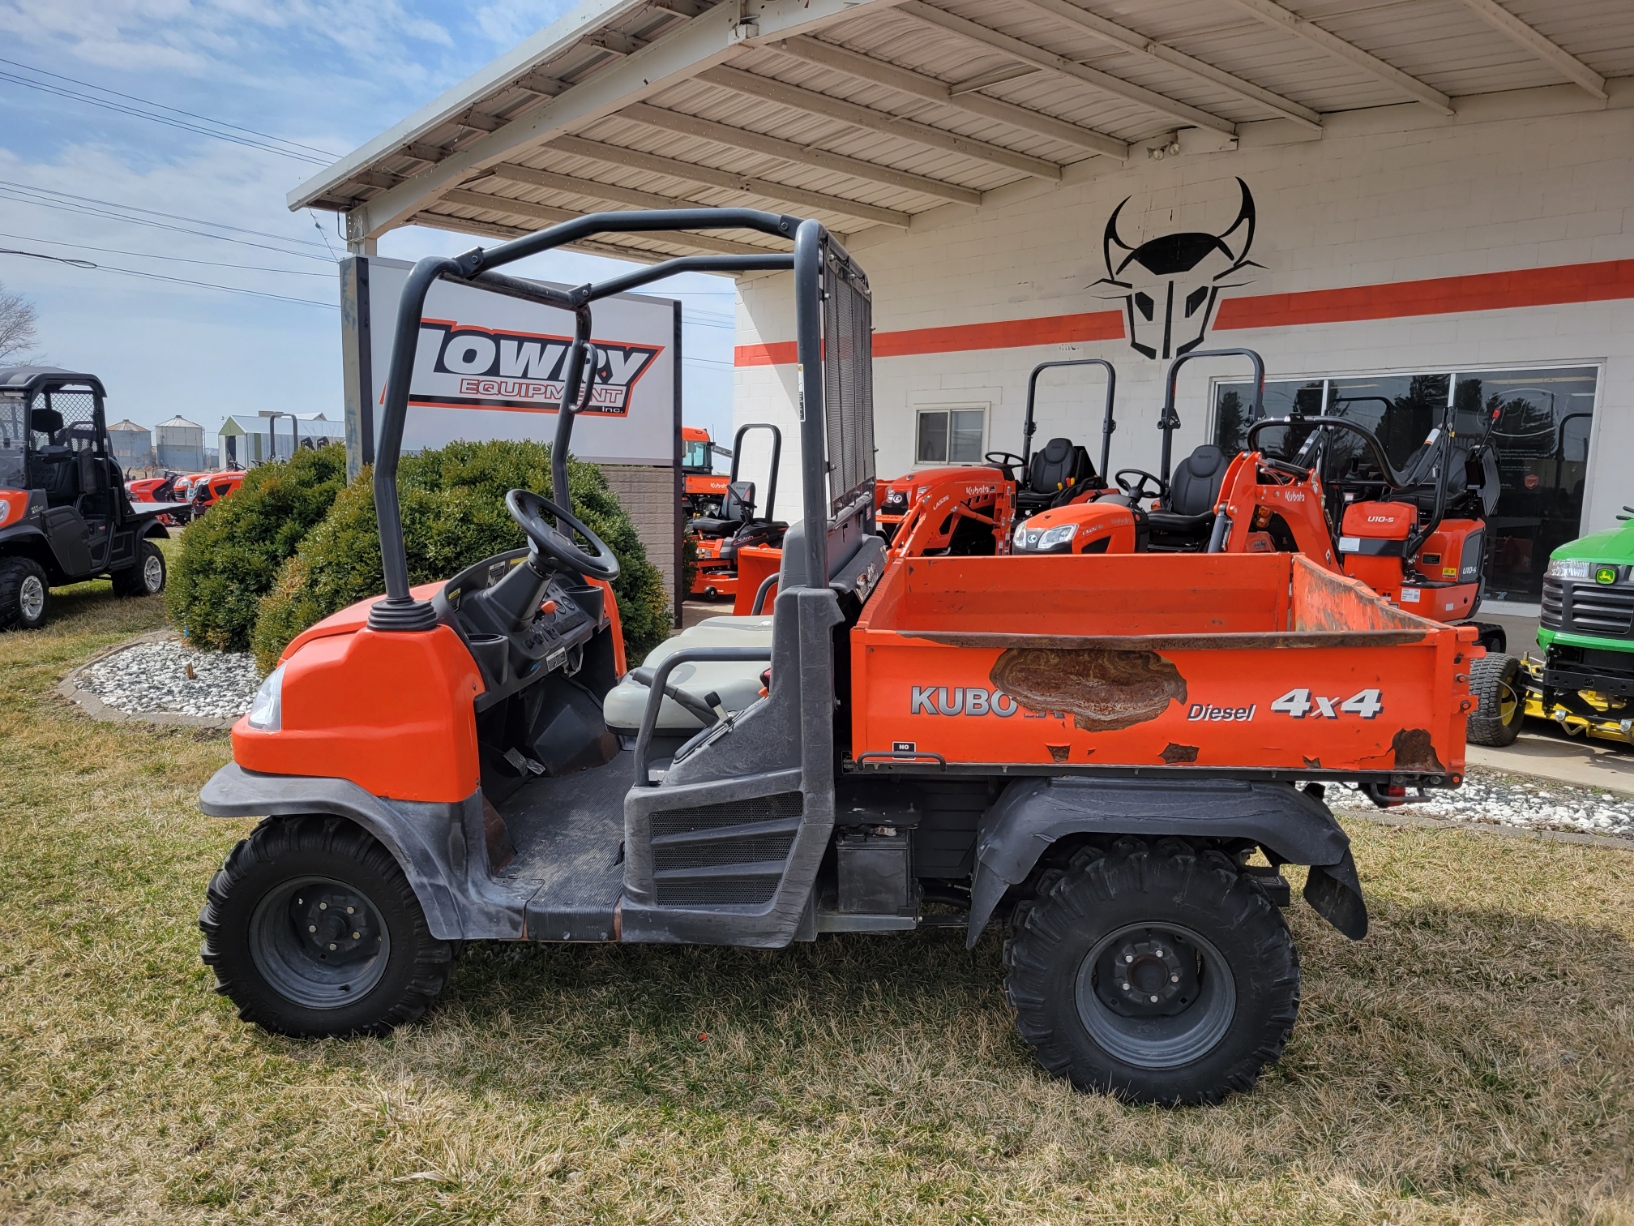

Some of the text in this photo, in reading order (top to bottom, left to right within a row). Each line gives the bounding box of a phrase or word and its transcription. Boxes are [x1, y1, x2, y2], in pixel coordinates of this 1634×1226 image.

[965, 485, 990, 495] Kubota
[911, 685, 1066, 719] KUBO
[1187, 688, 1385, 722] Diesel 4x4
